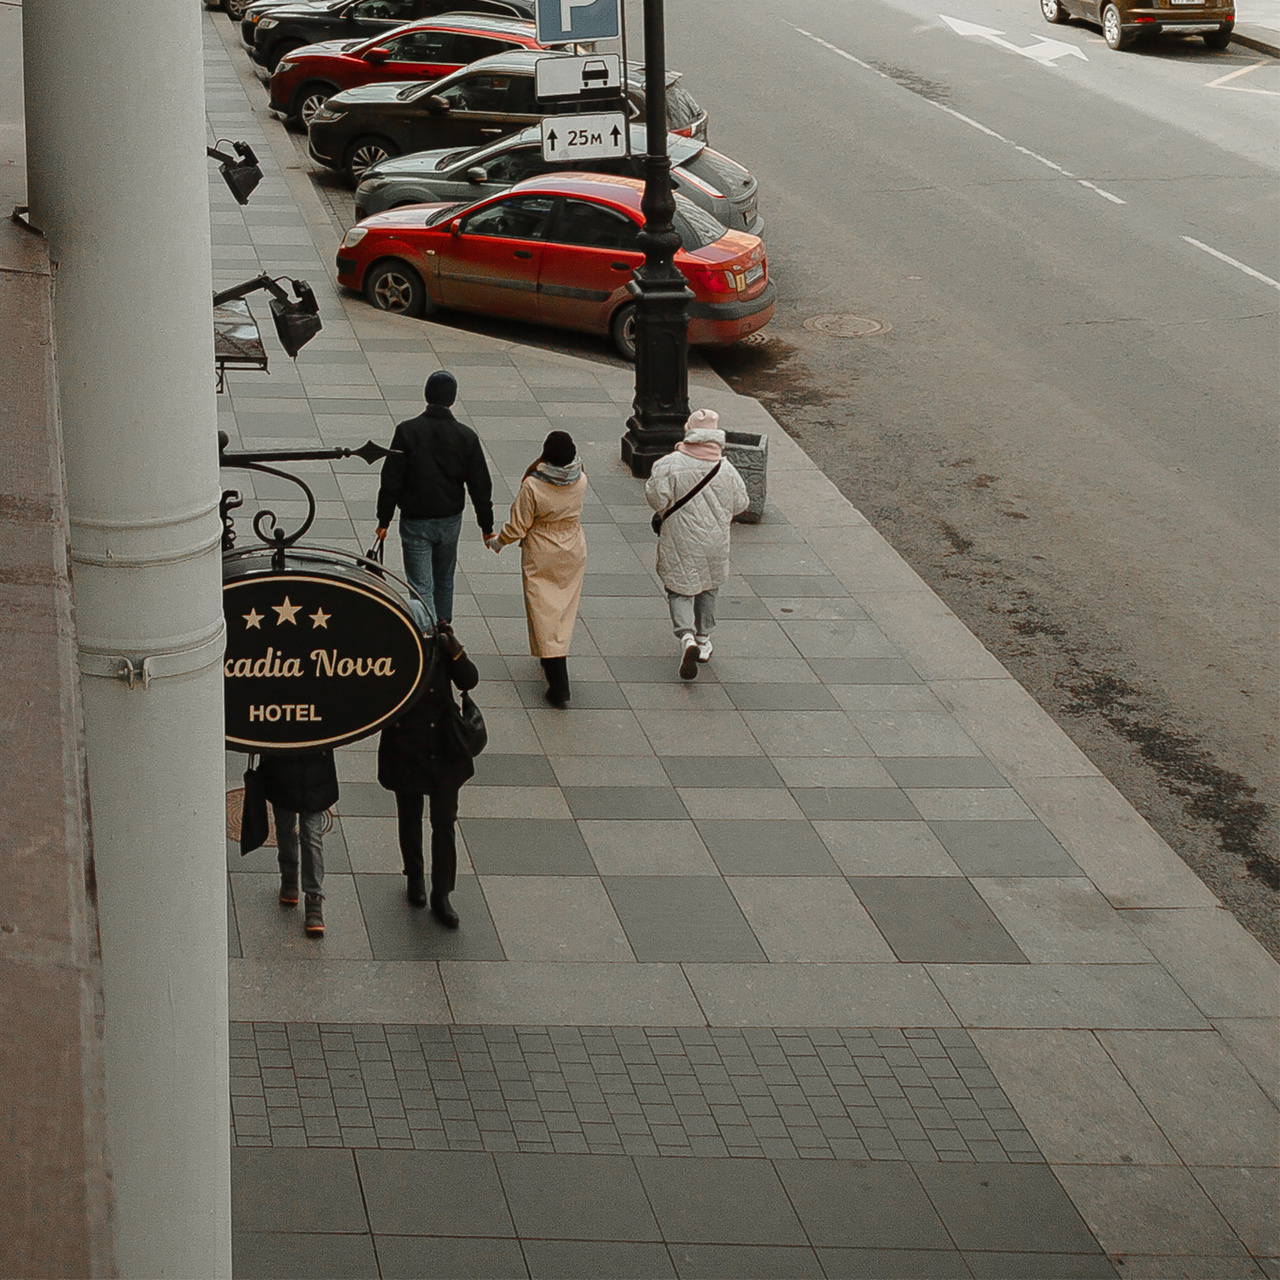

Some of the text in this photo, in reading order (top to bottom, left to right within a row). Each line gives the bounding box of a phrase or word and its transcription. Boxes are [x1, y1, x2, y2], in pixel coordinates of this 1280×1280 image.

[224, 646, 396, 678] kadia Nova
[249, 703, 323, 722] HOTEL
